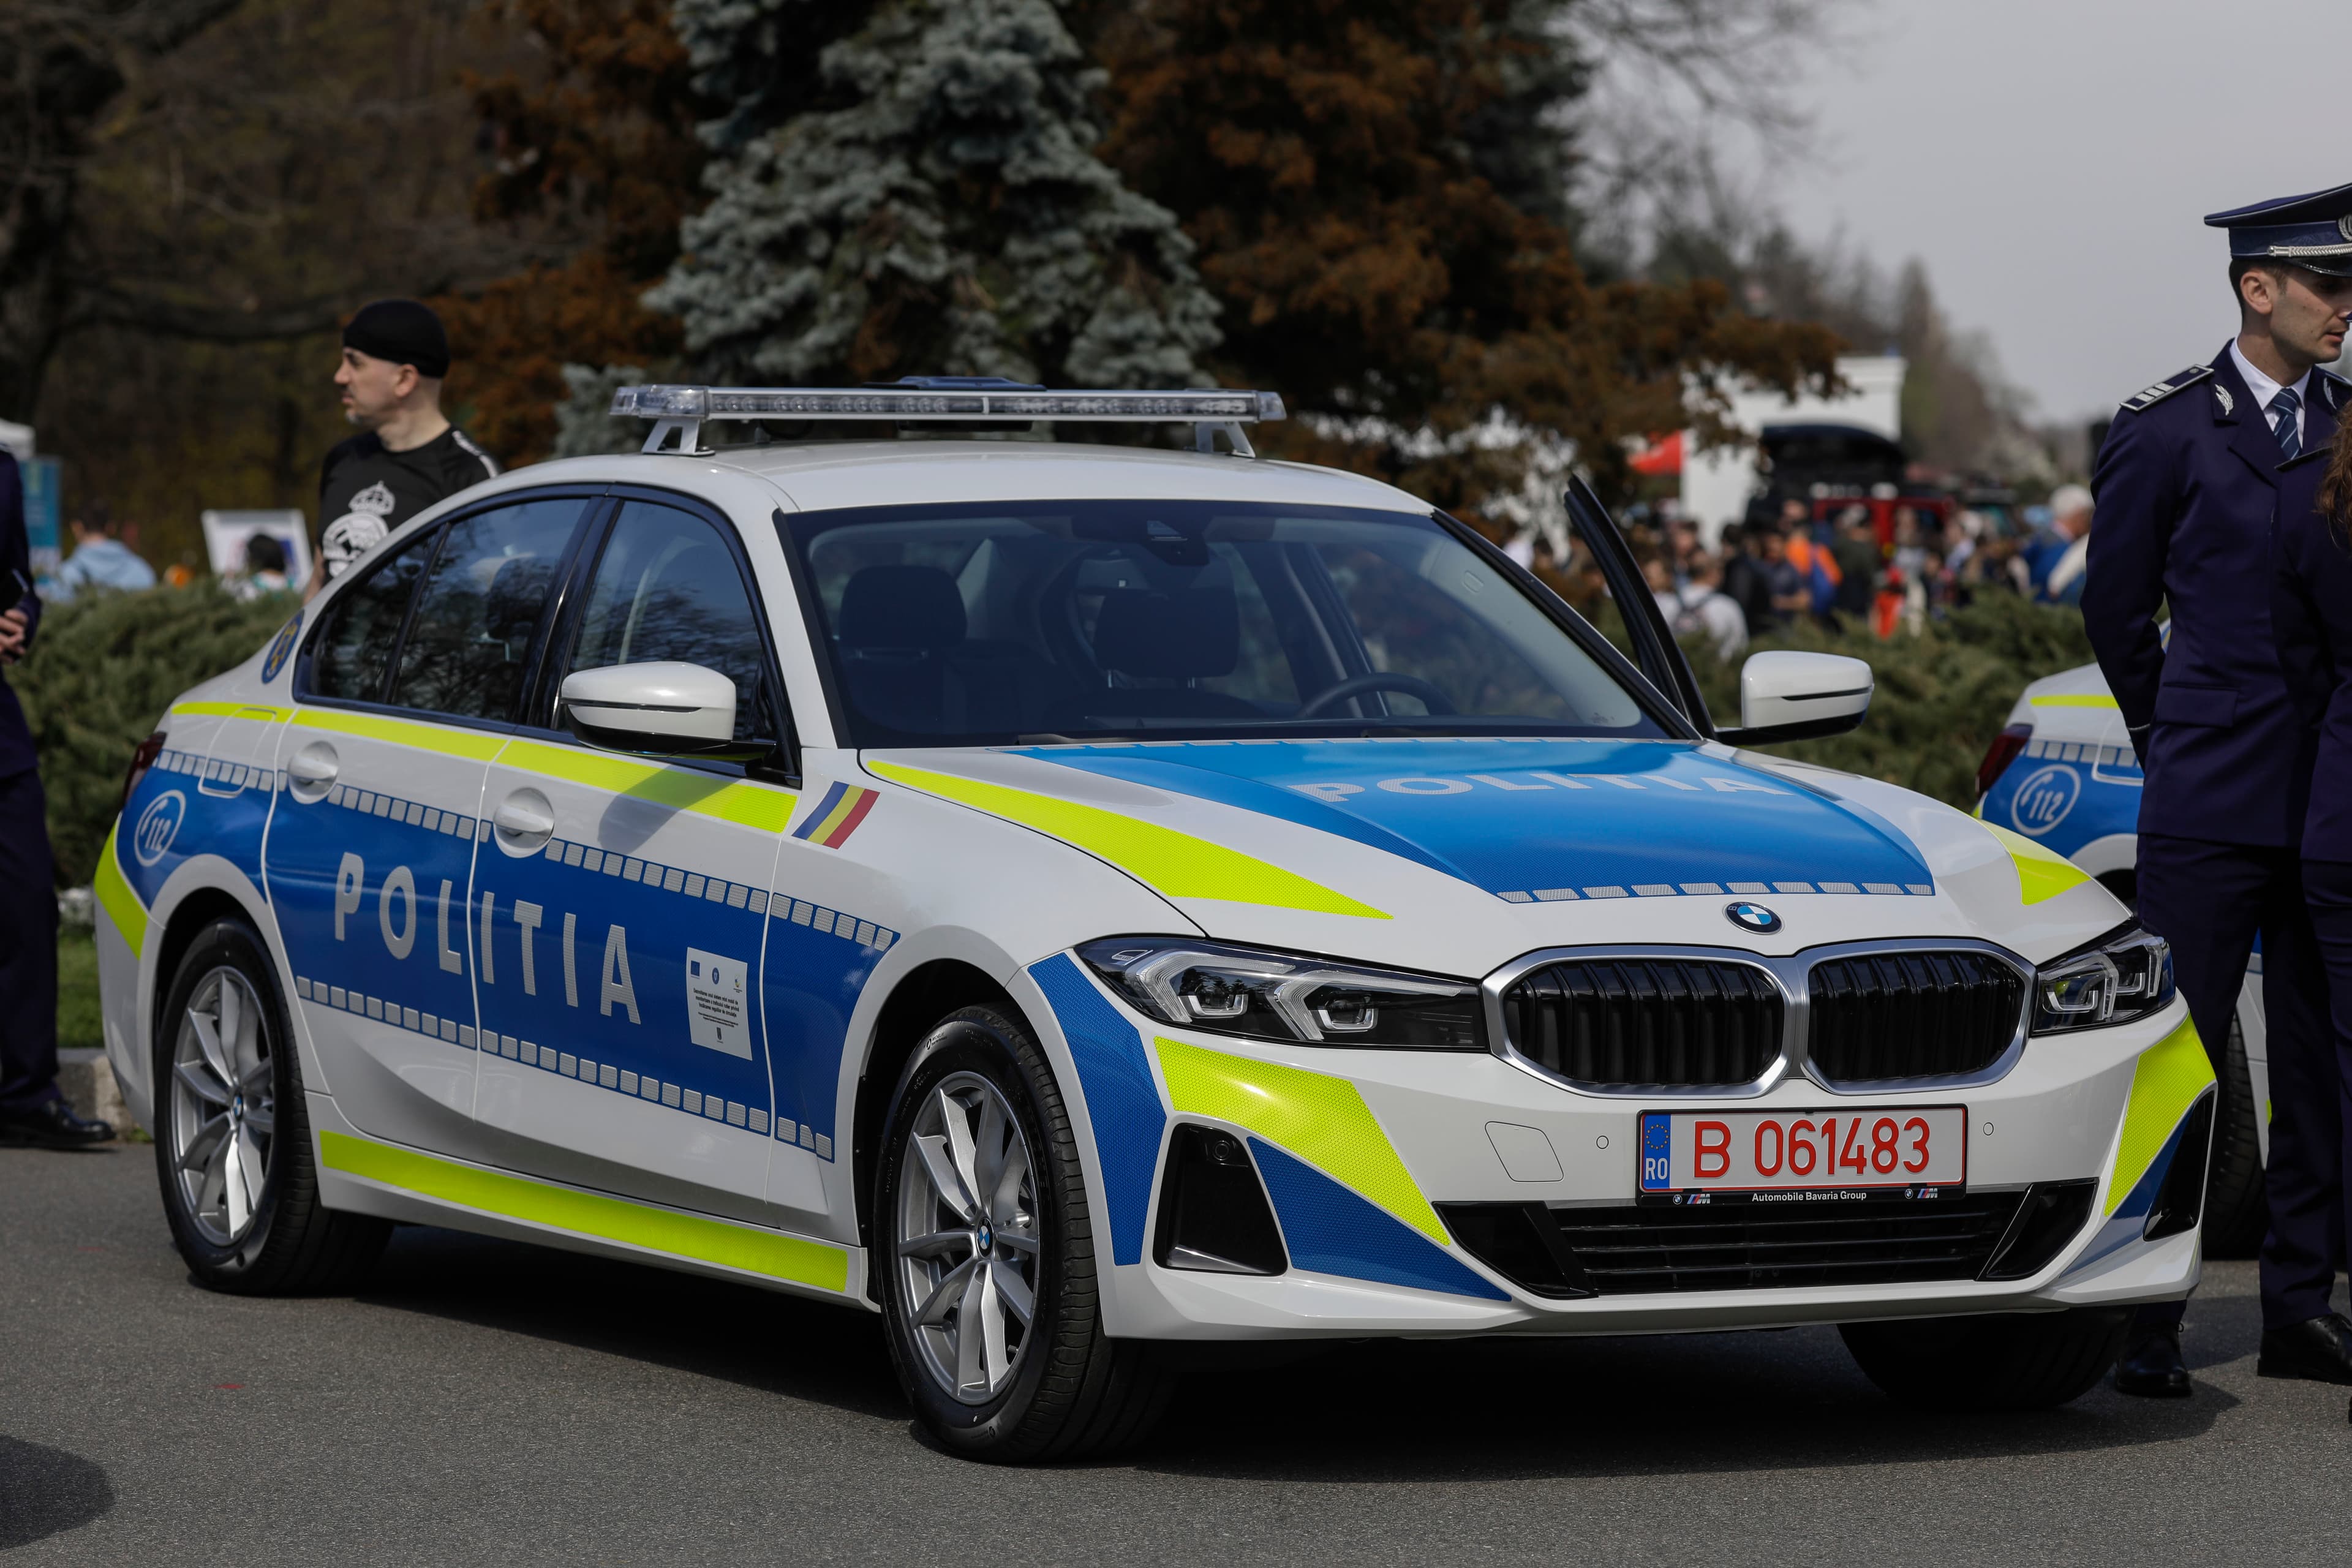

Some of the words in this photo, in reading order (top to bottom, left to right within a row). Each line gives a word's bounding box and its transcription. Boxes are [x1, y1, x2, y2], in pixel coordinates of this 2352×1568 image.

[1287, 772, 1795, 802] POLITIA
[2028, 790, 2064, 821] 112
[145, 816, 172, 851] 112
[334, 851, 641, 1025] POLITIA
[1694, 1120, 1732, 1179] B
[1754, 1117, 1931, 1177] 061483
[1645, 1158, 1668, 1180] RO
[1752, 1192, 1804, 1202] Automobile
[1806, 1191, 1838, 1200] Bavaria
[1840, 1191, 1867, 1200] Group
